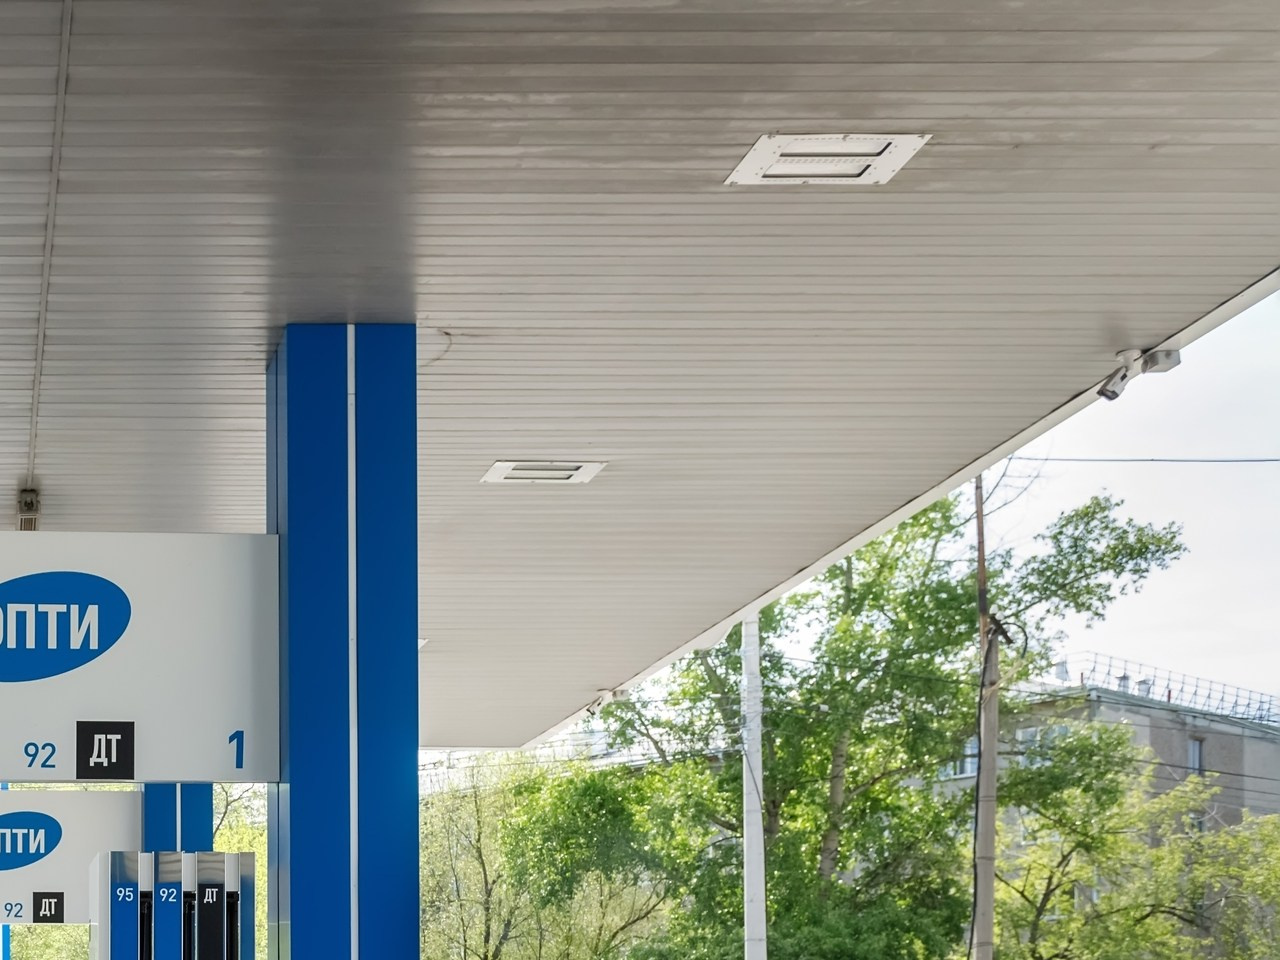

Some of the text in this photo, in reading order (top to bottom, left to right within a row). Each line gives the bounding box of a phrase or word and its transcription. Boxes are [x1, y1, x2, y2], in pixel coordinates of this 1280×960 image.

[23, 742, 57, 769] 92
[89, 734, 122, 767] ДТ
[228, 730, 245, 769] 1
[4, 903, 24, 918] 92
[39, 898, 58, 917] ДТ
[117, 887, 219, 904] 95 92 ДТ
